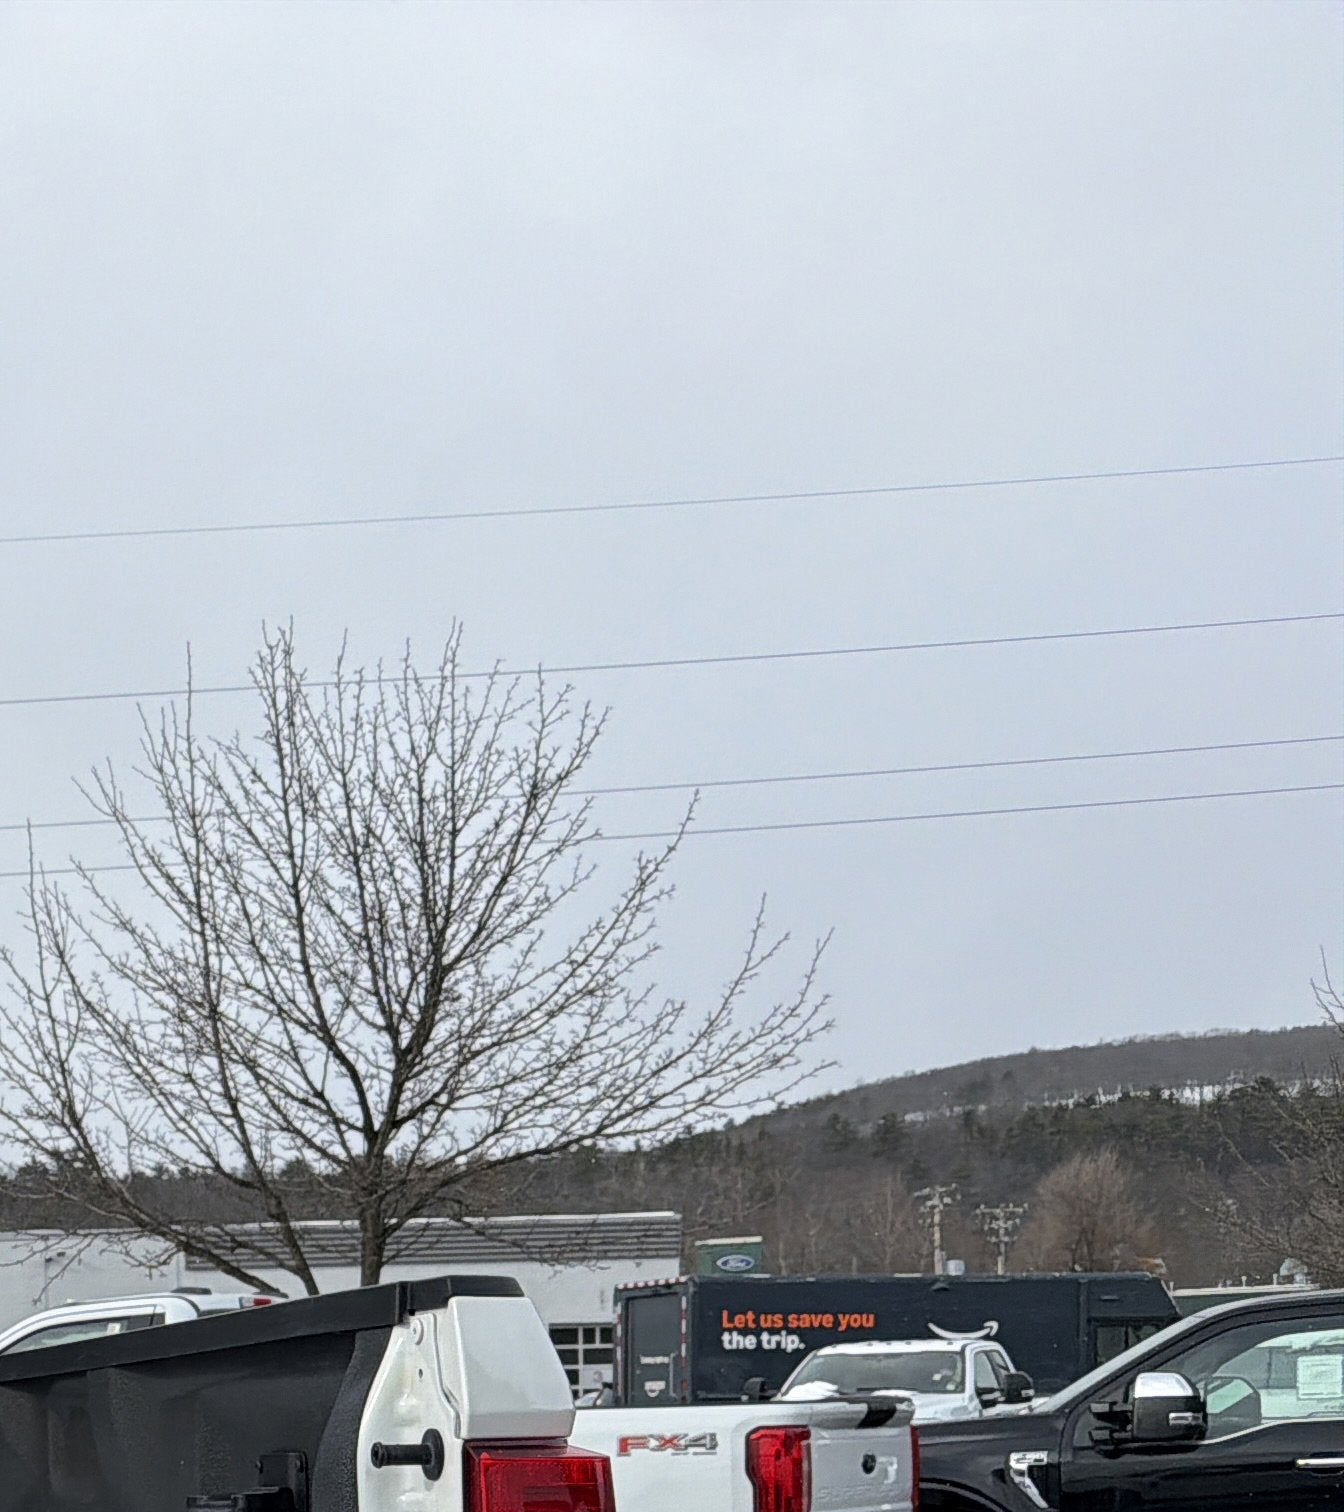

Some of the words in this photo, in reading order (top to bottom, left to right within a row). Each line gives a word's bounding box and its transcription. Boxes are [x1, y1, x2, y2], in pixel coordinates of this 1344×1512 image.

[721, 1310, 756, 1329] Let
[760, 1313, 783, 1329] us
[787, 1313, 833, 1329] save
[837, 1312, 875, 1332] you
[721, 1330, 757, 1349] the
[760, 1330, 806, 1352] trip.
[616, 1432, 718, 1457] FX4
